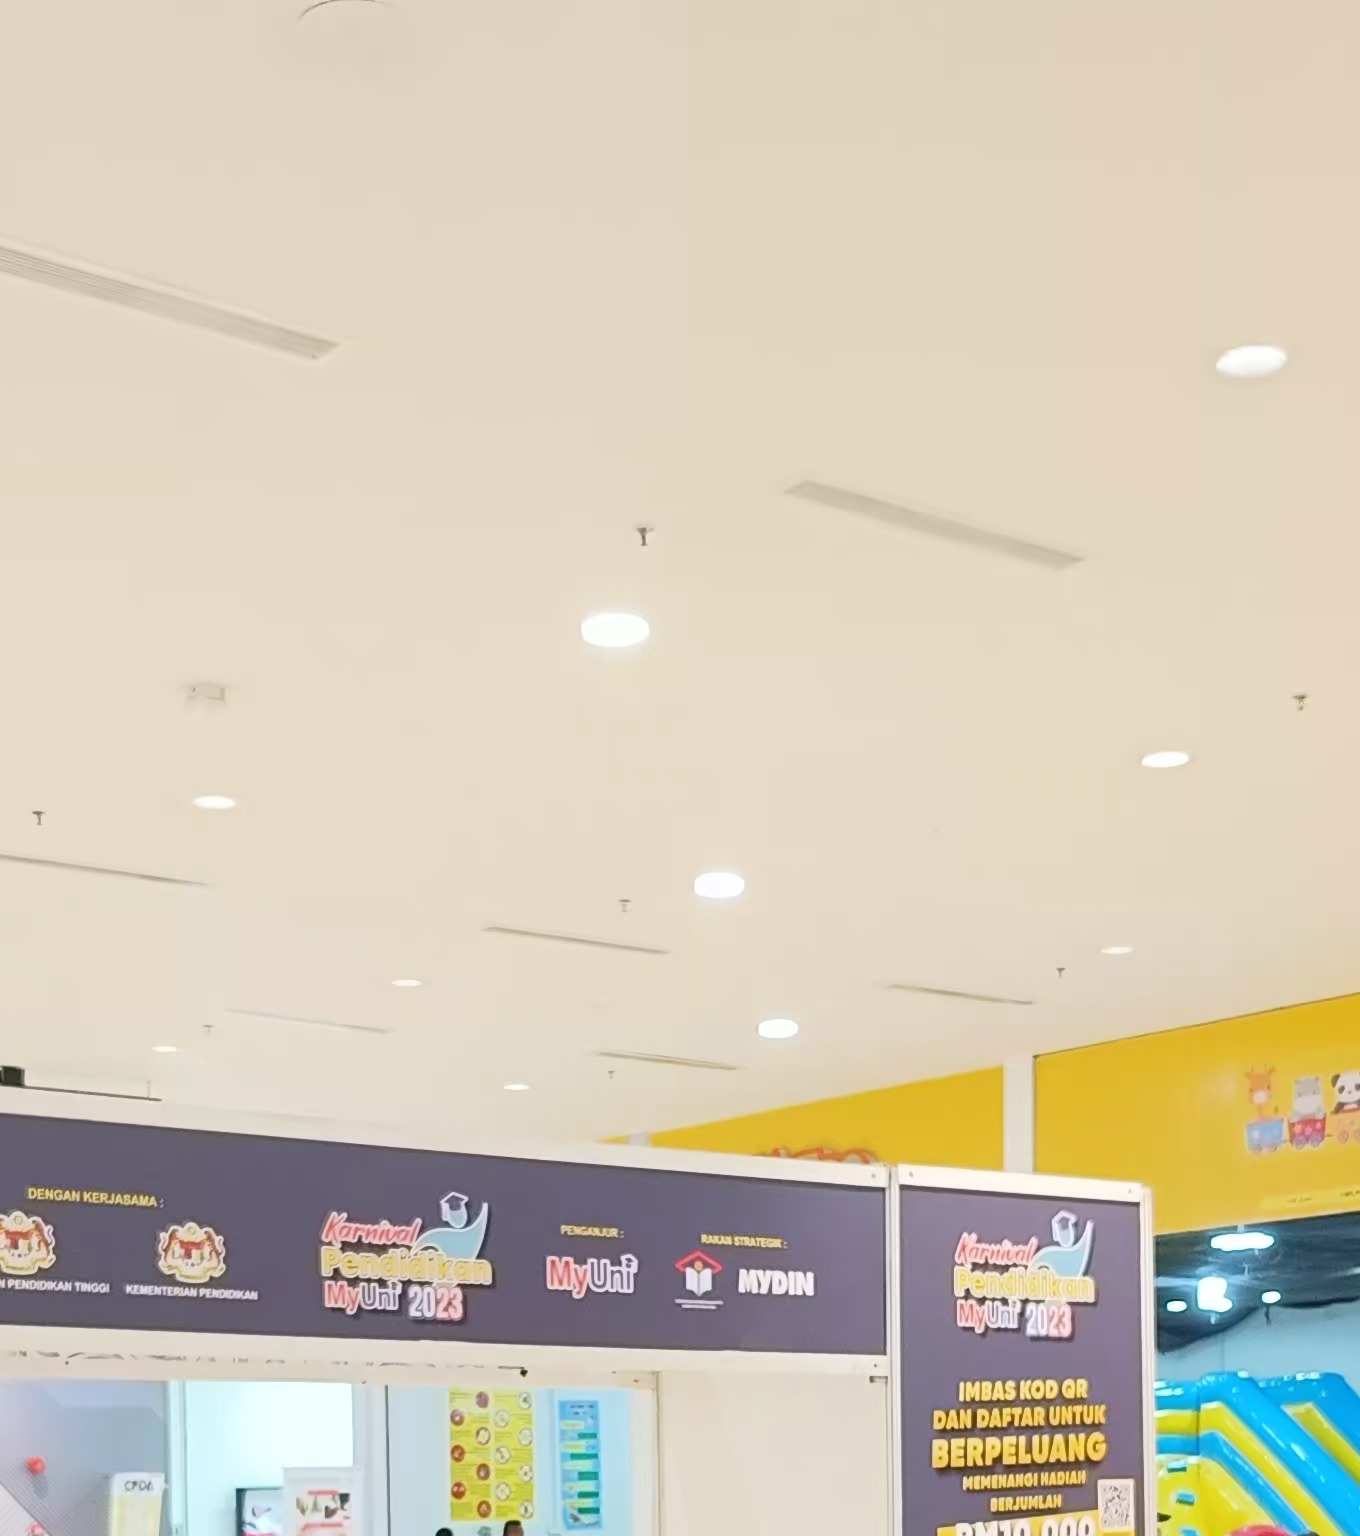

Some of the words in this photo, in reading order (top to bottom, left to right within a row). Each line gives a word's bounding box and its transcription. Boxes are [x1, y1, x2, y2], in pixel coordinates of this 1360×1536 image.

[28, 1187, 80, 1202] DENGAN
[83, 1191, 157, 1208] KERJASAMA
[322, 1211, 422, 1244] Karnival
[561, 1224, 618, 1239] PENGANJUR
[701, 1233, 732, 1246] RAKAN
[955, 1232, 1038, 1266] Karnival
[321, 1245, 492, 1286] Pendidikan
[546, 1254, 638, 1298] MyUni
[7, 1278, 71, 1292] PENDIDIKAN
[74, 1280, 110, 1293] TINGGI
[126, 1283, 197, 1298] KEMENTERIAN
[199, 1287, 258, 1300] PENDIDIKAN
[737, 1268, 815, 1297] MYDIN
[954, 1265, 1096, 1302] Pendidikan
[324, 1280, 400, 1316] MyUni
[408, 1284, 463, 1320] 2023
[956, 1299, 1019, 1334] MyUni
[1025, 1301, 1072, 1338] 2023
[959, 1381, 1016, 1402] IMBAS
[1019, 1379, 1059, 1400] KOD
[1061, 1378, 1088, 1399] QR
[933, 1408, 972, 1431] DAN
[977, 1406, 1045, 1429] DAFTAR
[1049, 1404, 1106, 1427] UNTUK
[931, 1432, 1108, 1469] BERPELUANG
[962, 1472, 1038, 1491] MEMENANGI
[1040, 1470, 1087, 1488] HADIAH
[990, 1494, 1062, 1513] BERJUMLAH
